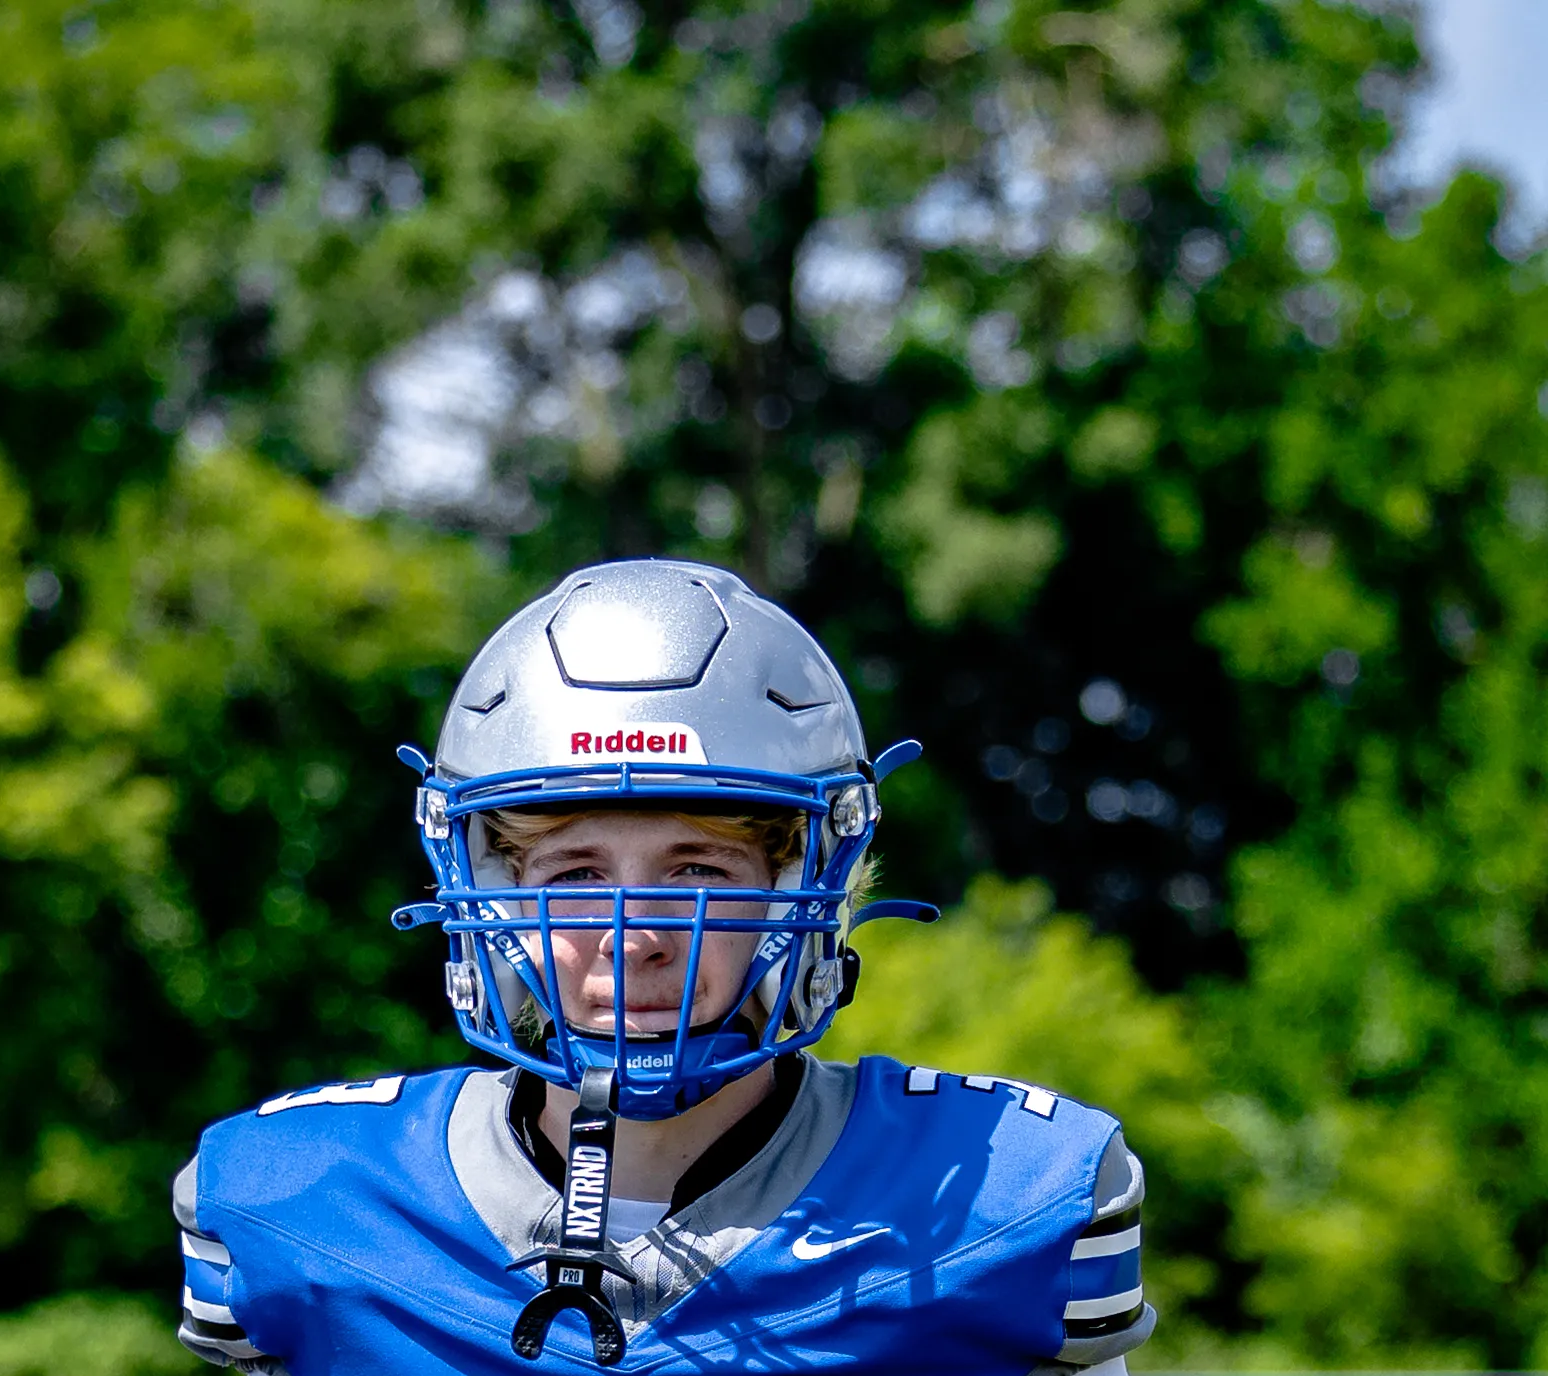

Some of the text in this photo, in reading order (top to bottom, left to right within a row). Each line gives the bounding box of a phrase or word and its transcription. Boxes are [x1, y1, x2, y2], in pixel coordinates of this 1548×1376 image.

[571, 730, 687, 754] Riddell
[566, 1146, 607, 1238] NXTRND
[562, 1269, 580, 1283] PRO
